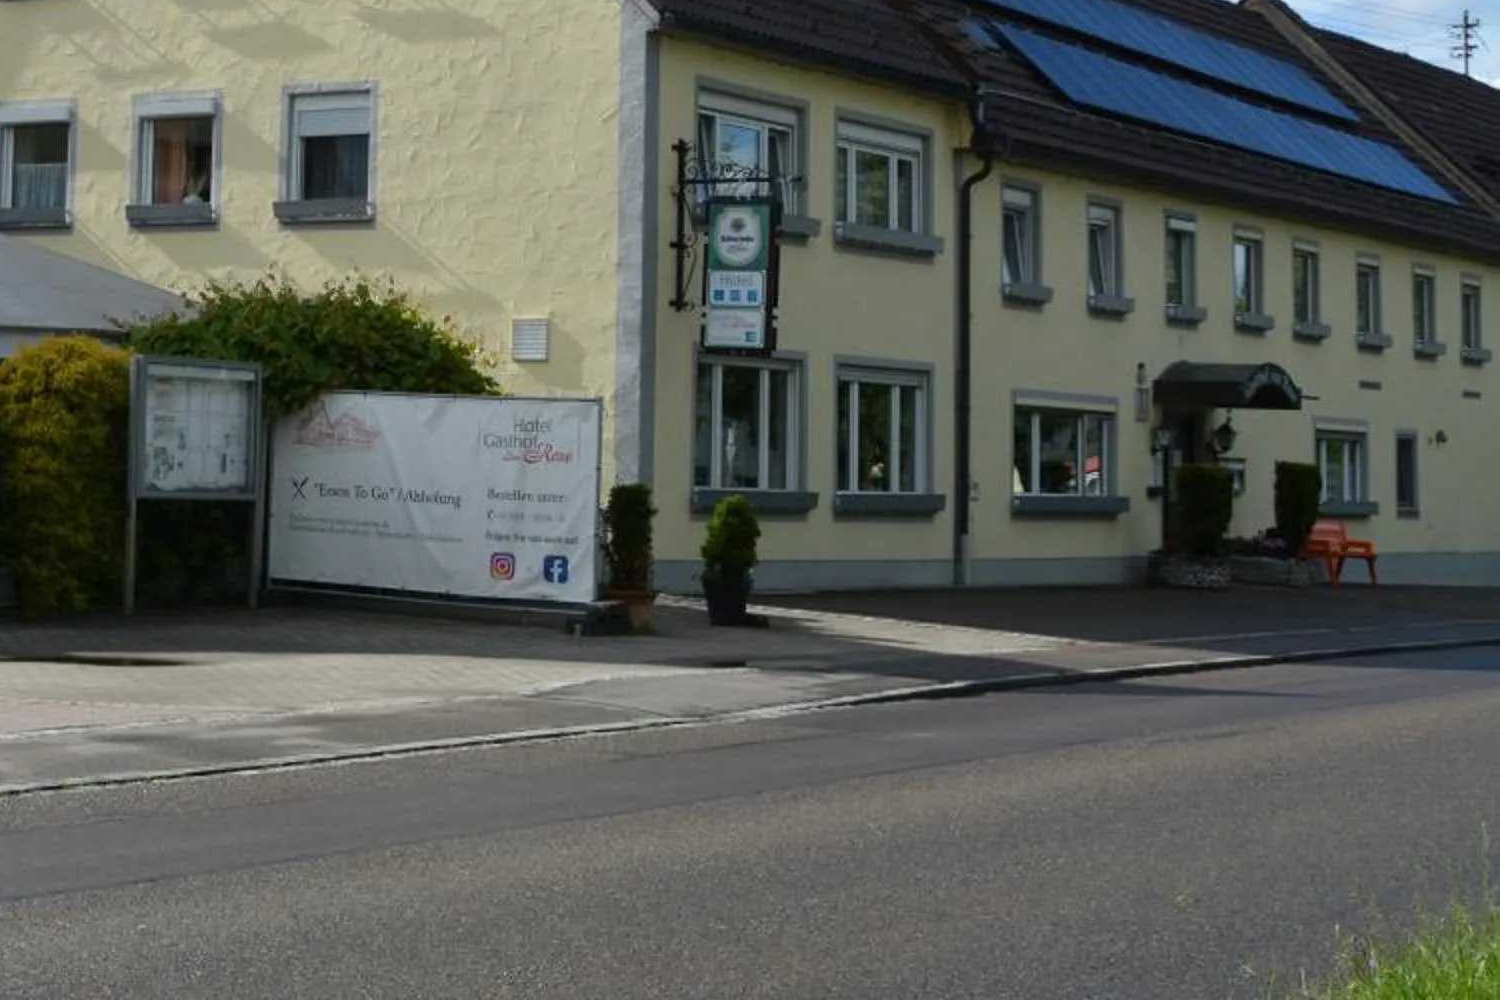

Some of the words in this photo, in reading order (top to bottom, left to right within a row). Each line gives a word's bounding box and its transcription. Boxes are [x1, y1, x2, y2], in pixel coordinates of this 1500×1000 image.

[514, 418, 551, 433] Hotel
[483, 433, 538, 449] Gasthof
[353, 485, 369, 500] To
